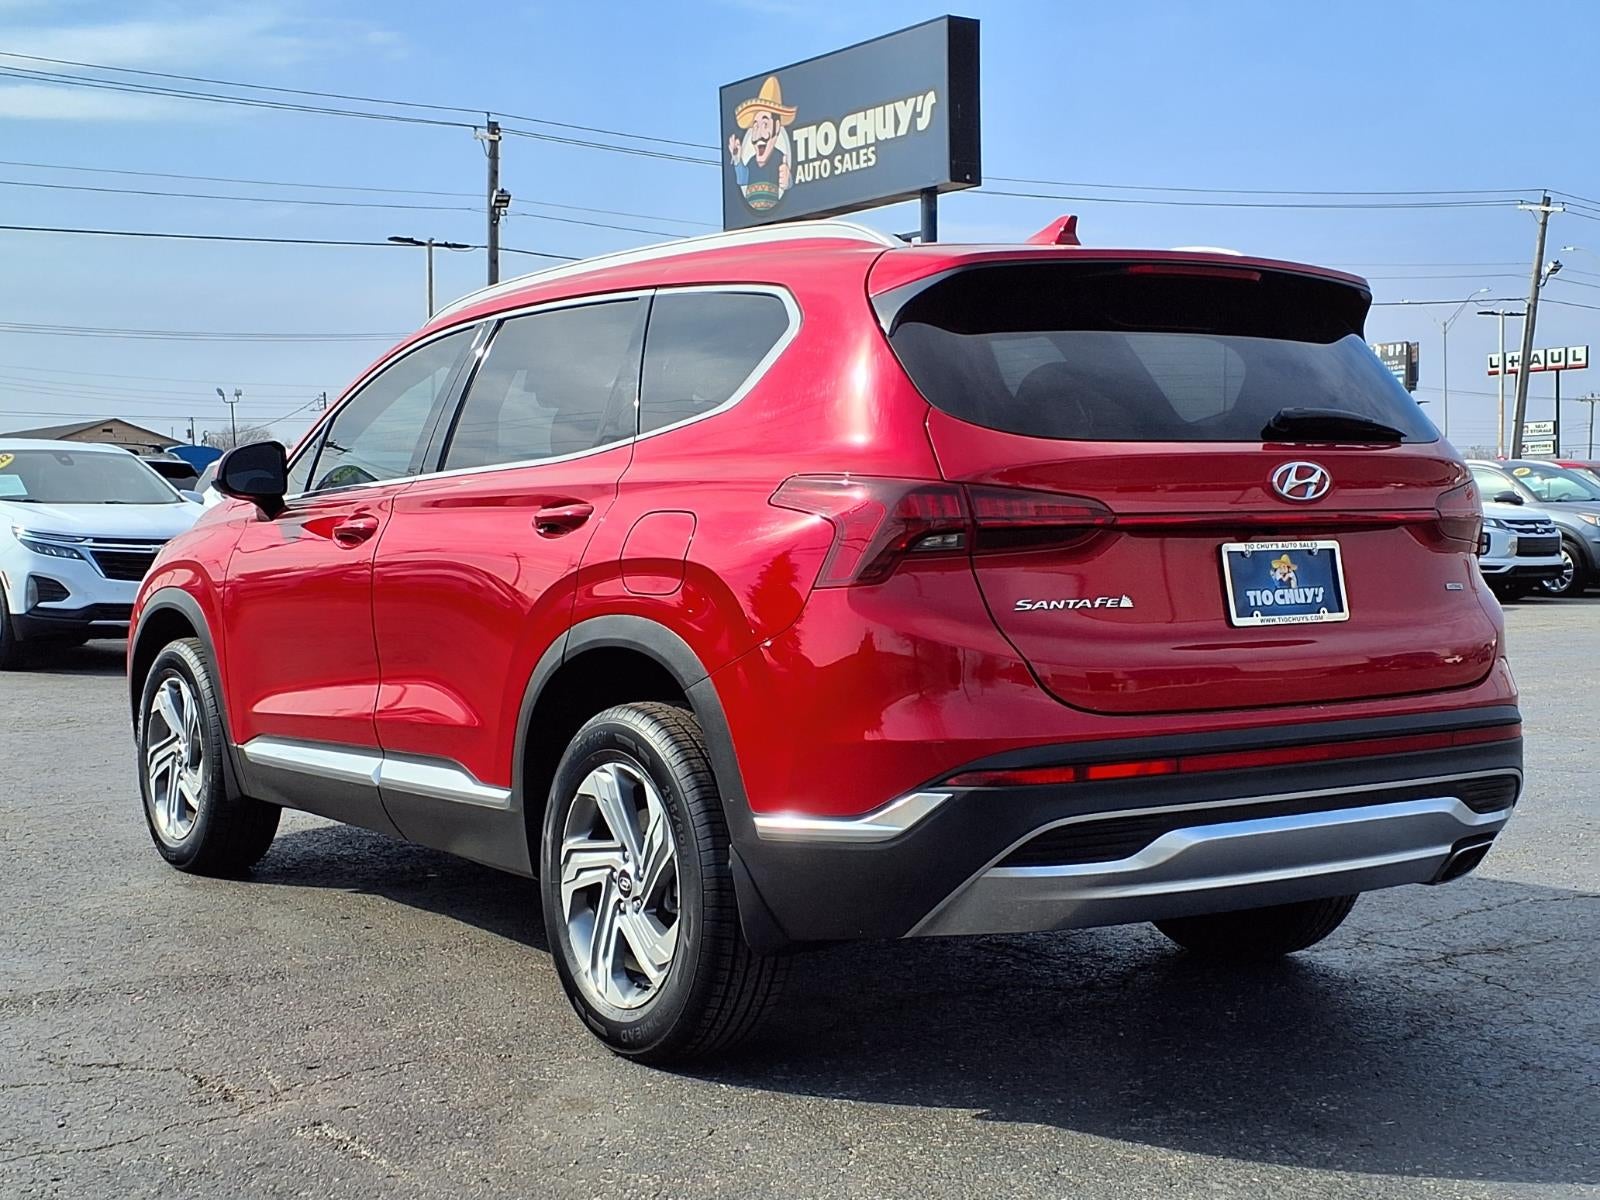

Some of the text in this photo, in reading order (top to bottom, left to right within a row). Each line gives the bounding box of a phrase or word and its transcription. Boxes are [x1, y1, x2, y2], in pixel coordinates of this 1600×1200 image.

[793, 90, 937, 161] TIO CHUY'S
[795, 147, 876, 184] AUTO SALES
[1014, 597, 1120, 611] SANTA FE
[1246, 587, 1324, 606] TIO CHUY'S
